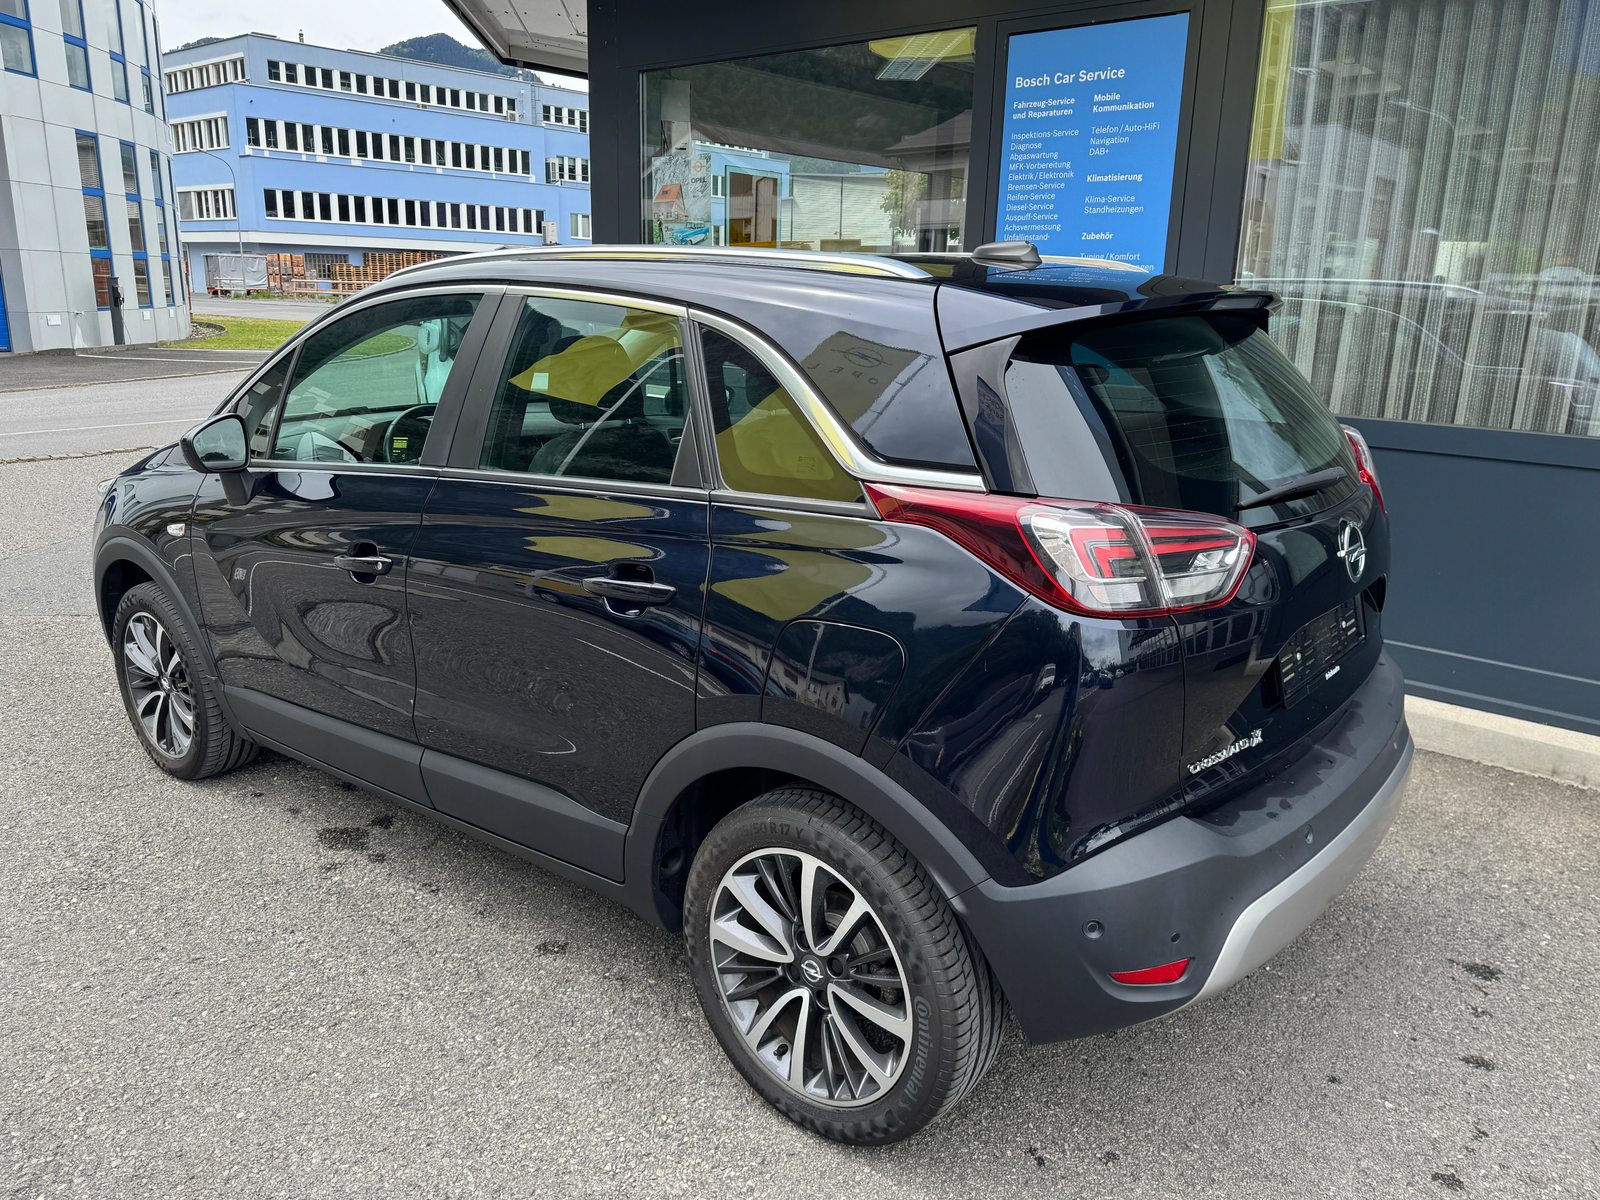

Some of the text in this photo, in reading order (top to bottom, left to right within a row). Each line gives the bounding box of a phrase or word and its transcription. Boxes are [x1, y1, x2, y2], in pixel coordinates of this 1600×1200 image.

[1015, 67, 1125, 88] Bosch Car Service
[1094, 93, 1120, 102] Mobile
[1014, 97, 1075, 110] Fahrzeug-Service
[1093, 101, 1154, 112] Kommunikation
[1028, 108, 1073, 119] Reparaturen
[1011, 129, 1079, 141] Inspektions-Service
[1090, 136, 1129, 146] Navigation
[1011, 142, 1042, 151] Diagnose
[1010, 152, 1058, 160] Abgaswartung
[1009, 162, 1070, 171] MFK-Vorbereitung
[1087, 174, 1142, 183] Klimatisierung
[1008, 182, 1065, 191] Bremsen-Service
[1007, 193, 1055, 201] Reifen-Service
[1085, 195, 1135, 203] Klima-Service
[1006, 203, 1054, 211] Diesel-Service
[1084, 206, 1143, 214] Standheizungen
[1005, 213, 1058, 222] Auspuff-Service
[1004, 223, 1061, 231] Achsvermessung
[904, 995, 932, 1103] Continental
